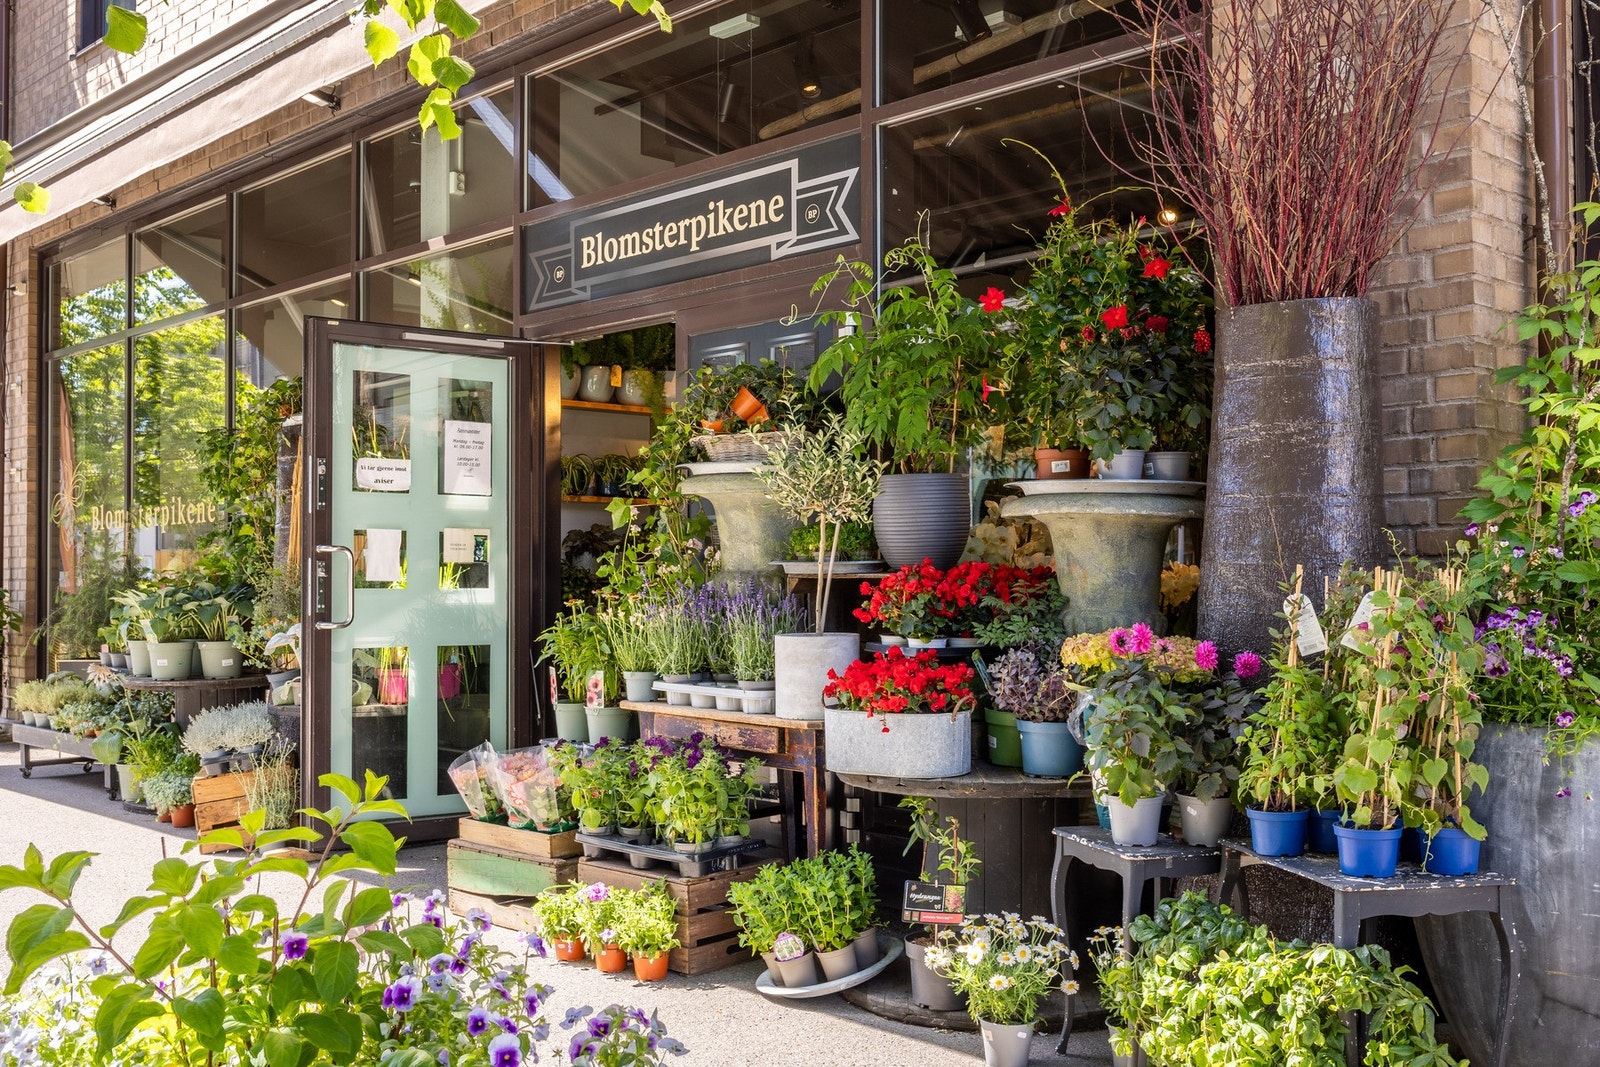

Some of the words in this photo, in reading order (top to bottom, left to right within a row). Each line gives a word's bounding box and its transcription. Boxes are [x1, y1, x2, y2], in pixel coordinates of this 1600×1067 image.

[808, 210, 818, 219] BP
[580, 195, 784, 268] Blomsterpikene
[556, 270, 564, 278] BP
[910, 892, 942, 902] Hydrangea
